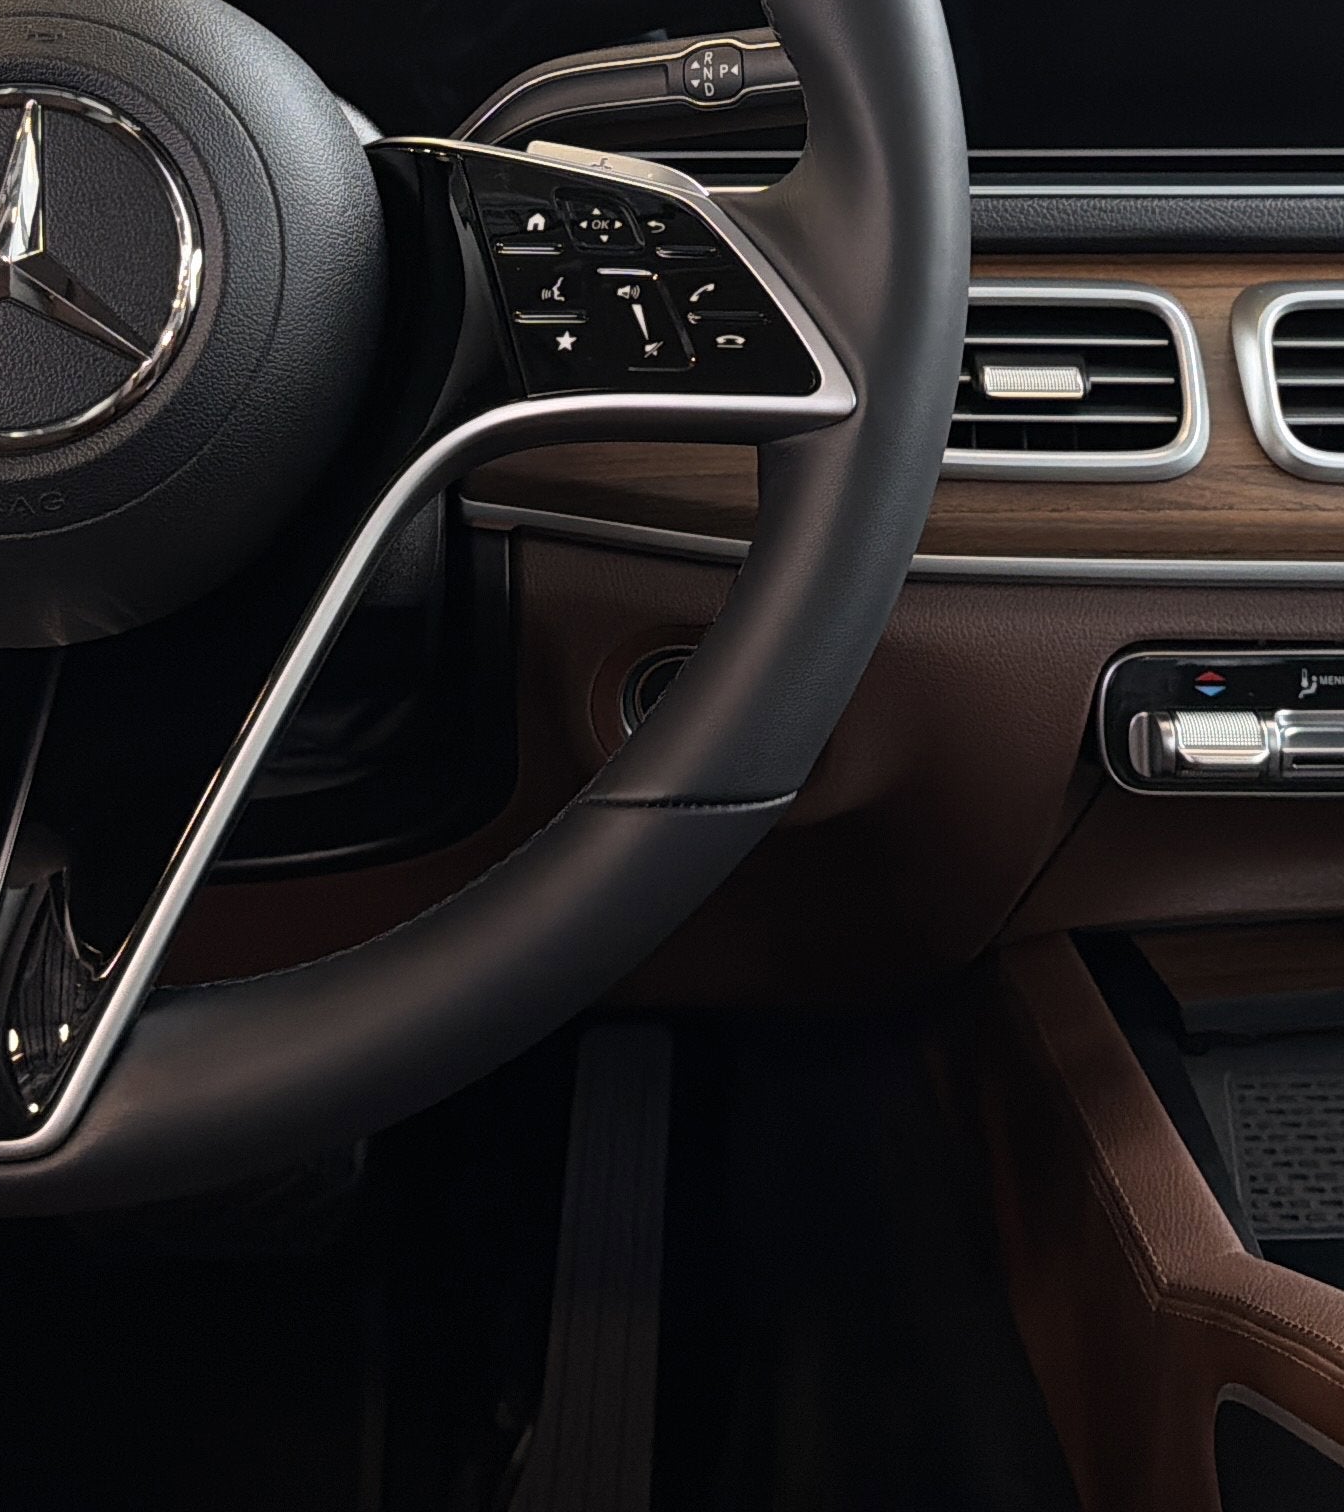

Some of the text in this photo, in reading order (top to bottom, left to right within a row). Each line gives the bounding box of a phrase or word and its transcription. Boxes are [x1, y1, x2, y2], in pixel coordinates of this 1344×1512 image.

[703, 51, 713, 65] R
[703, 66, 713, 80] N
[719, 64, 729, 78] P
[703, 82, 715, 97] D
[591, 219, 611, 231] OK
